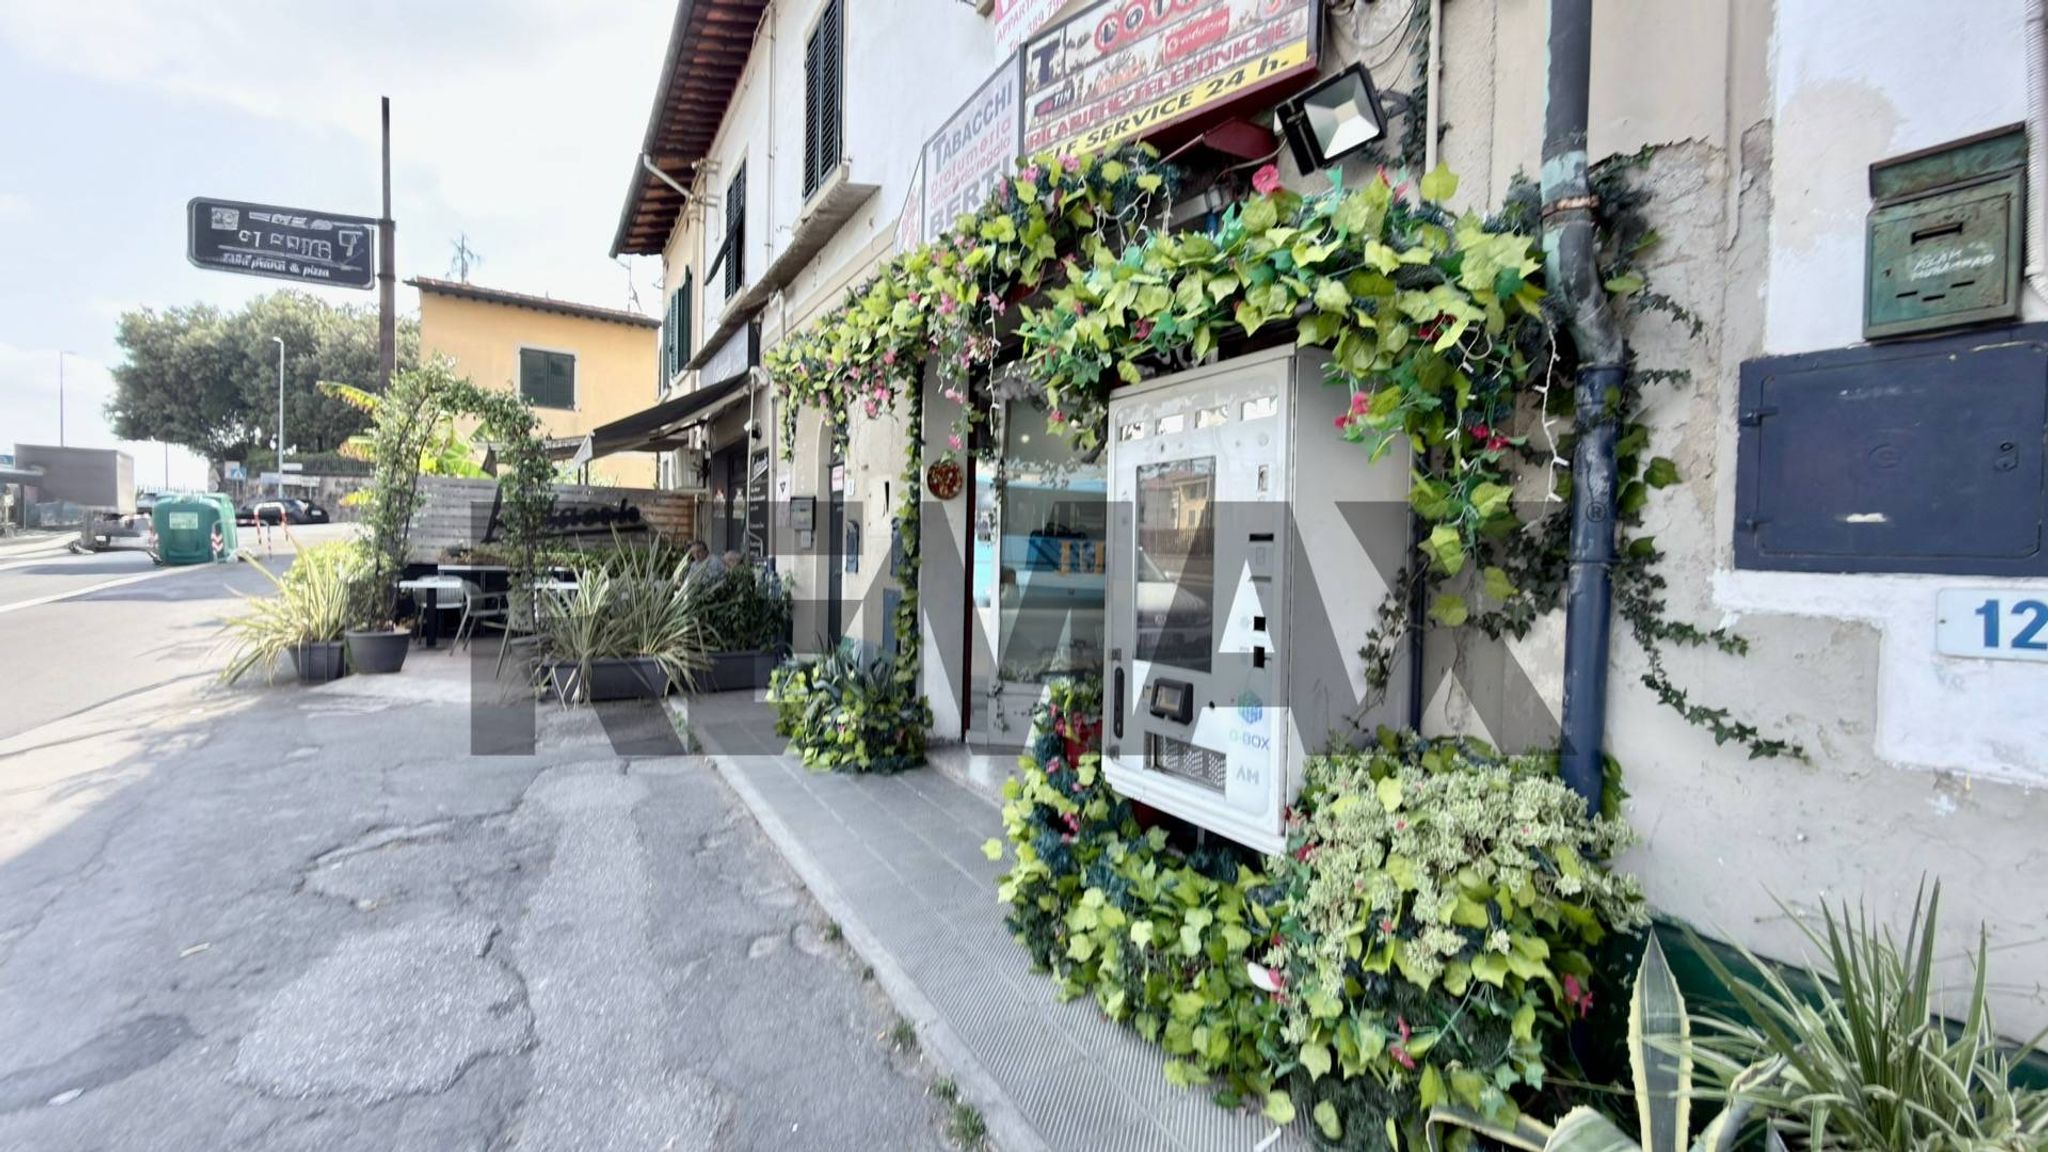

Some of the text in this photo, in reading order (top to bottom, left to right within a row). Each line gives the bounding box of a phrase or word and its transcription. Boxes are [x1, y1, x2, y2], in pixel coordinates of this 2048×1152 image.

[932, 80, 1013, 173] TABACCHI
[1086, 90, 1194, 147] SERVICE
[1205, 68, 1246, 98] 24
[1975, 599, 2048, 650] 12
